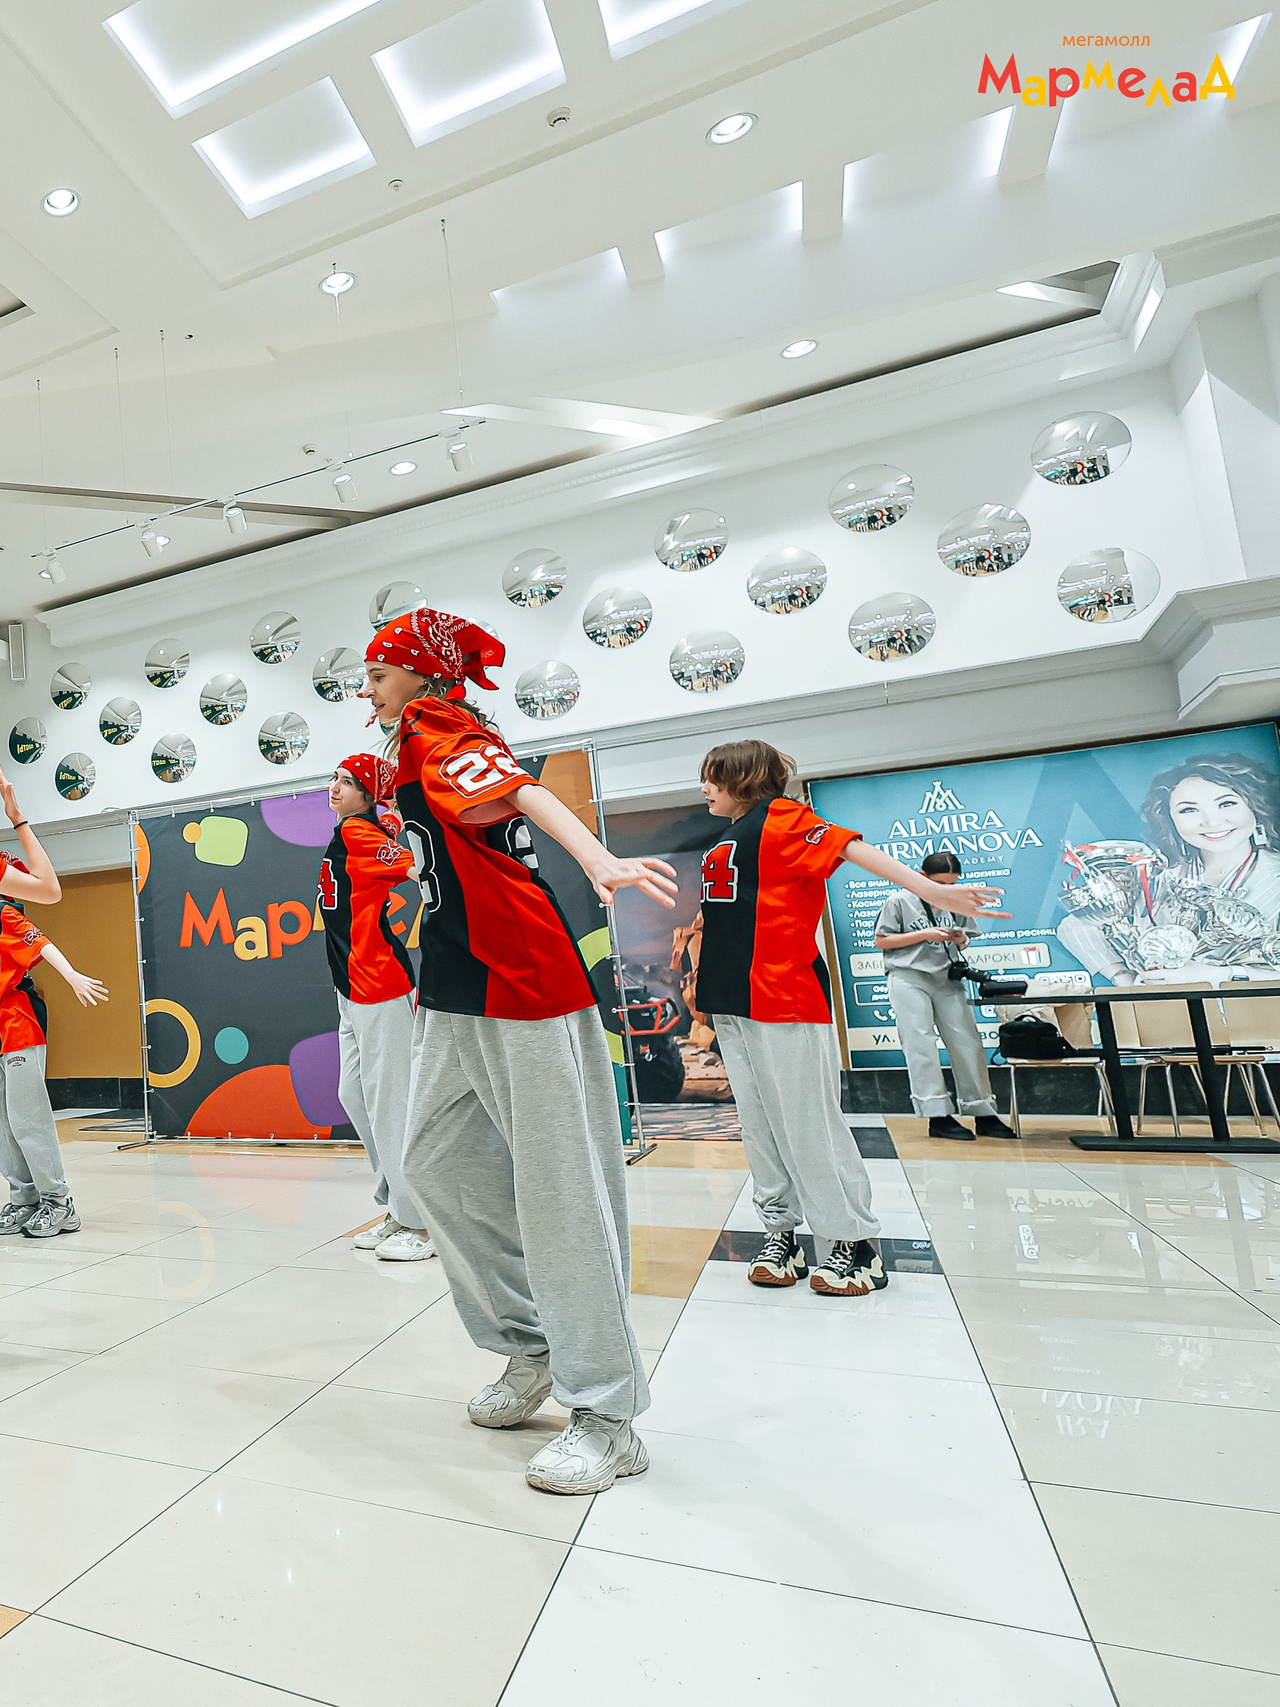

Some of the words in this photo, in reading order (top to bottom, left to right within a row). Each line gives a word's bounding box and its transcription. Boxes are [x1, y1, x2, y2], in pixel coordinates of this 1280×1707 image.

[888, 809, 1005, 840] ALMIRA
[957, 854, 1004, 866] ADEMY
[965, 869, 1011, 880] макияжа
[1016, 928, 1057, 940] ресниц
